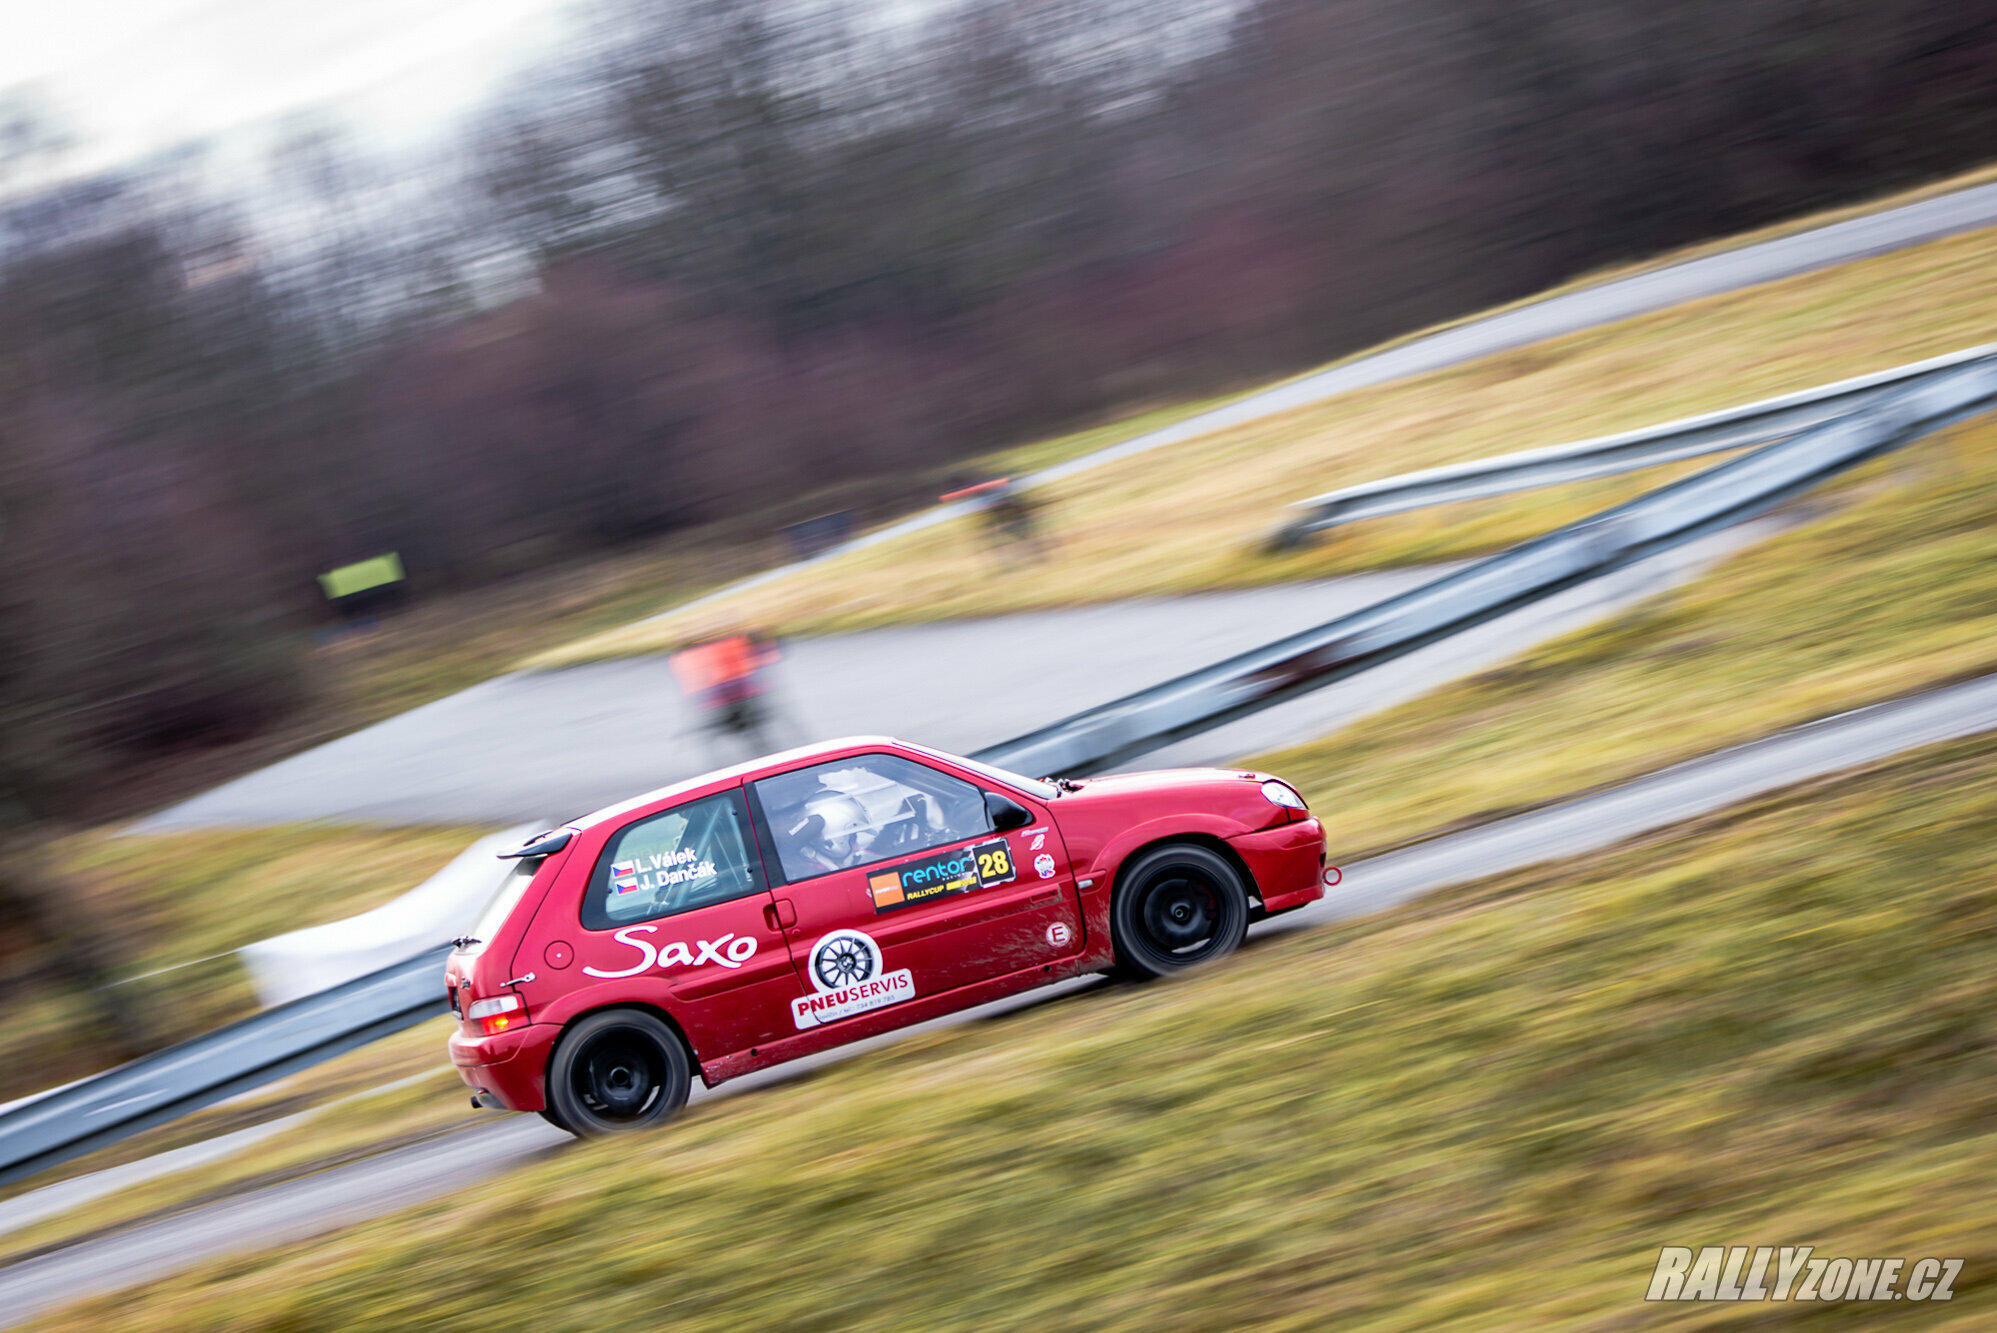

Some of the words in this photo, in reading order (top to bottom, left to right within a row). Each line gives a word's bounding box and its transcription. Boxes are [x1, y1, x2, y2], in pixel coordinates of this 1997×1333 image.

[640, 875, 655, 890] J.
[655, 861, 718, 887] Dančák
[902, 857, 971, 887] rentor
[978, 850, 1010, 879] 28
[906, 885, 945, 901] RALLYCUP
[1051, 926, 1066, 943] E
[582, 925, 758, 979] Saxo
[797, 974, 909, 1017] PNEUSERVIS
